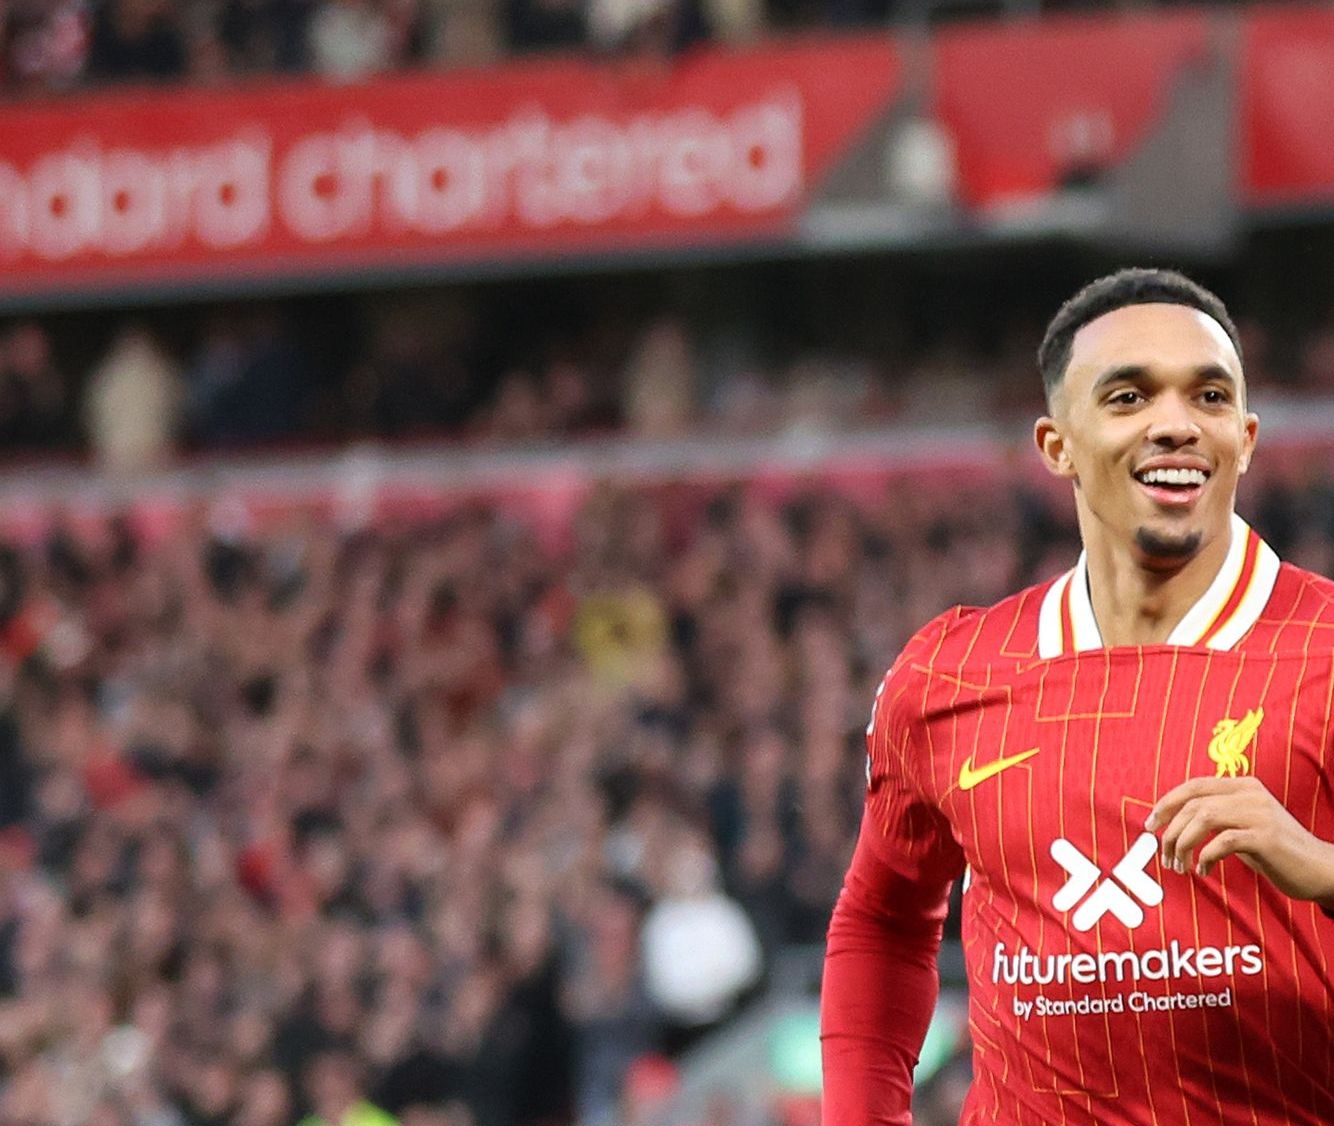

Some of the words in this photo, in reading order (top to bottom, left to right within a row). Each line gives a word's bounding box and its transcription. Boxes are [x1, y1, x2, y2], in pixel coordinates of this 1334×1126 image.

[281, 86, 799, 240] chartered
[992, 939, 1263, 985] futuremakers
[1013, 996, 1033, 1021] by
[1035, 992, 1124, 1017] Standard
[1128, 987, 1232, 1012] Chartered
